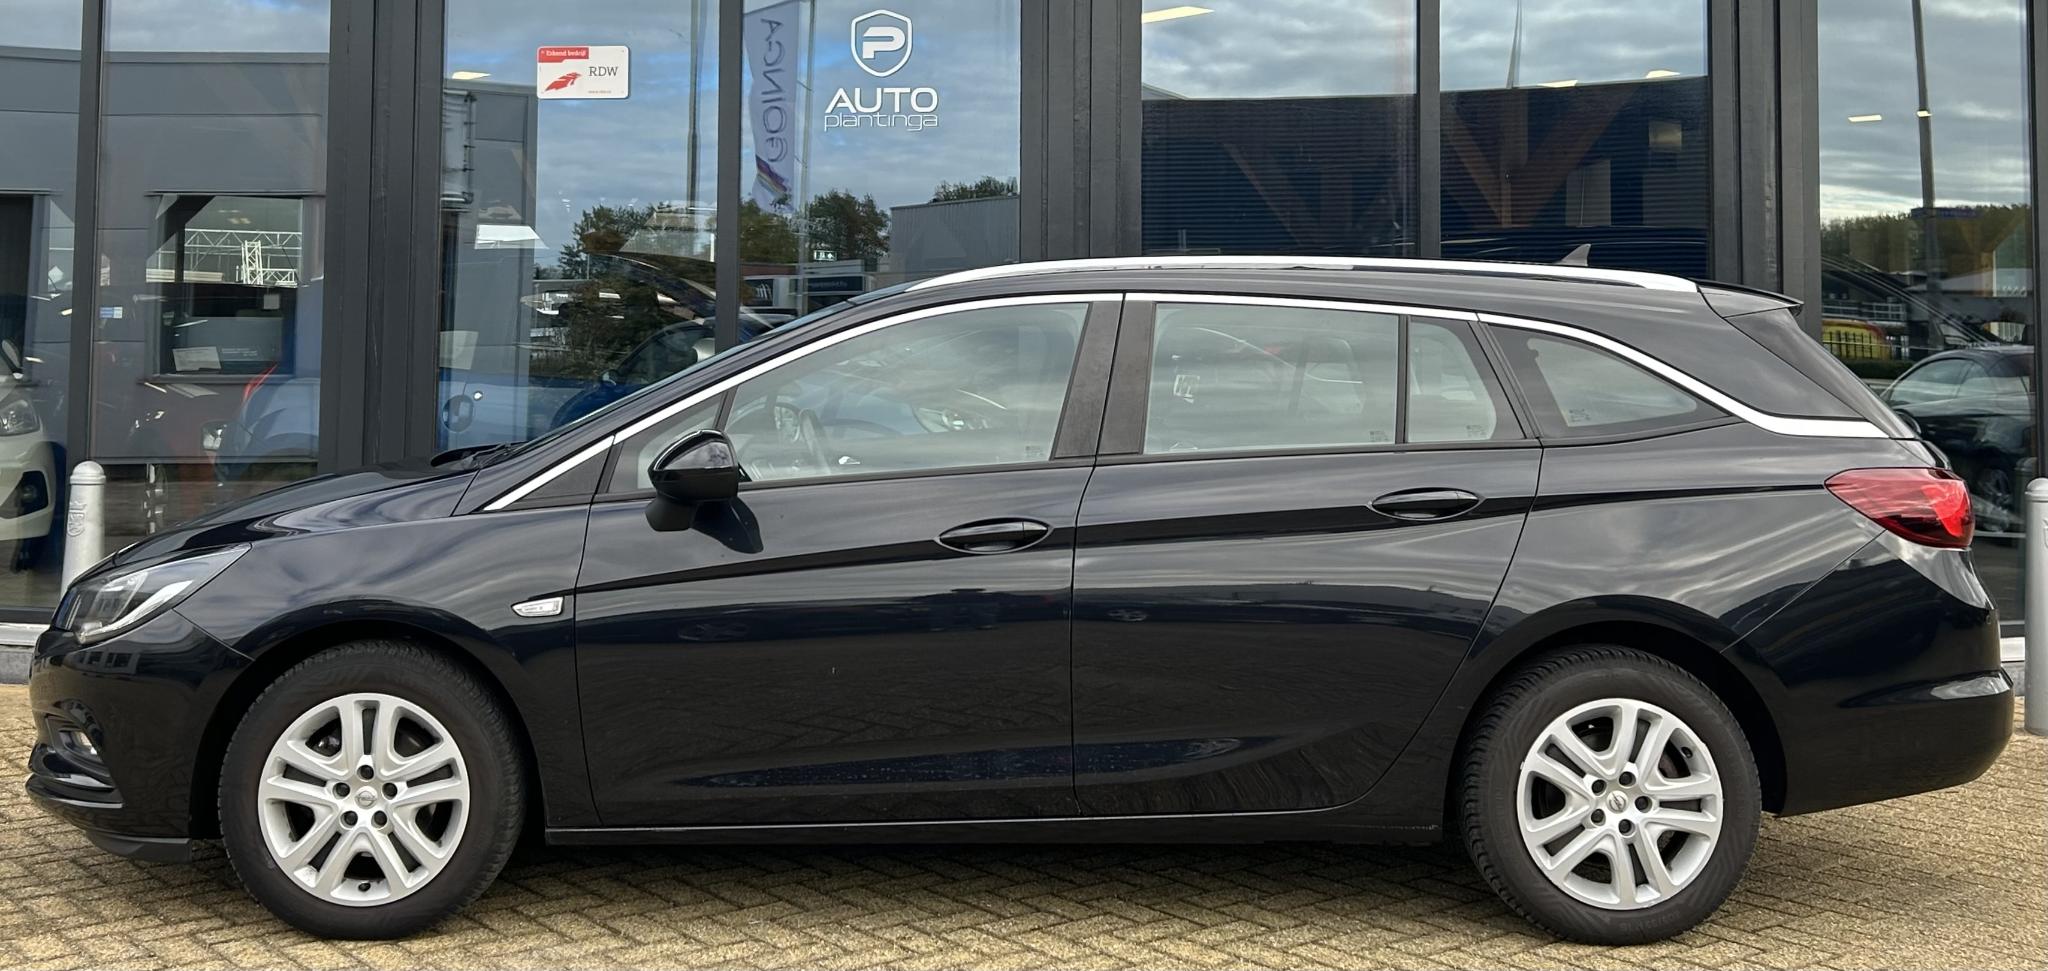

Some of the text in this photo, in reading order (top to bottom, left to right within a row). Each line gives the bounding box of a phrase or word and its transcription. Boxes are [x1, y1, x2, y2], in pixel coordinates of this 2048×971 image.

[862, 26, 906, 59] P
[589, 66, 619, 77] RDW
[825, 87, 939, 114] AUTO
[824, 113, 939, 132] plantinga
